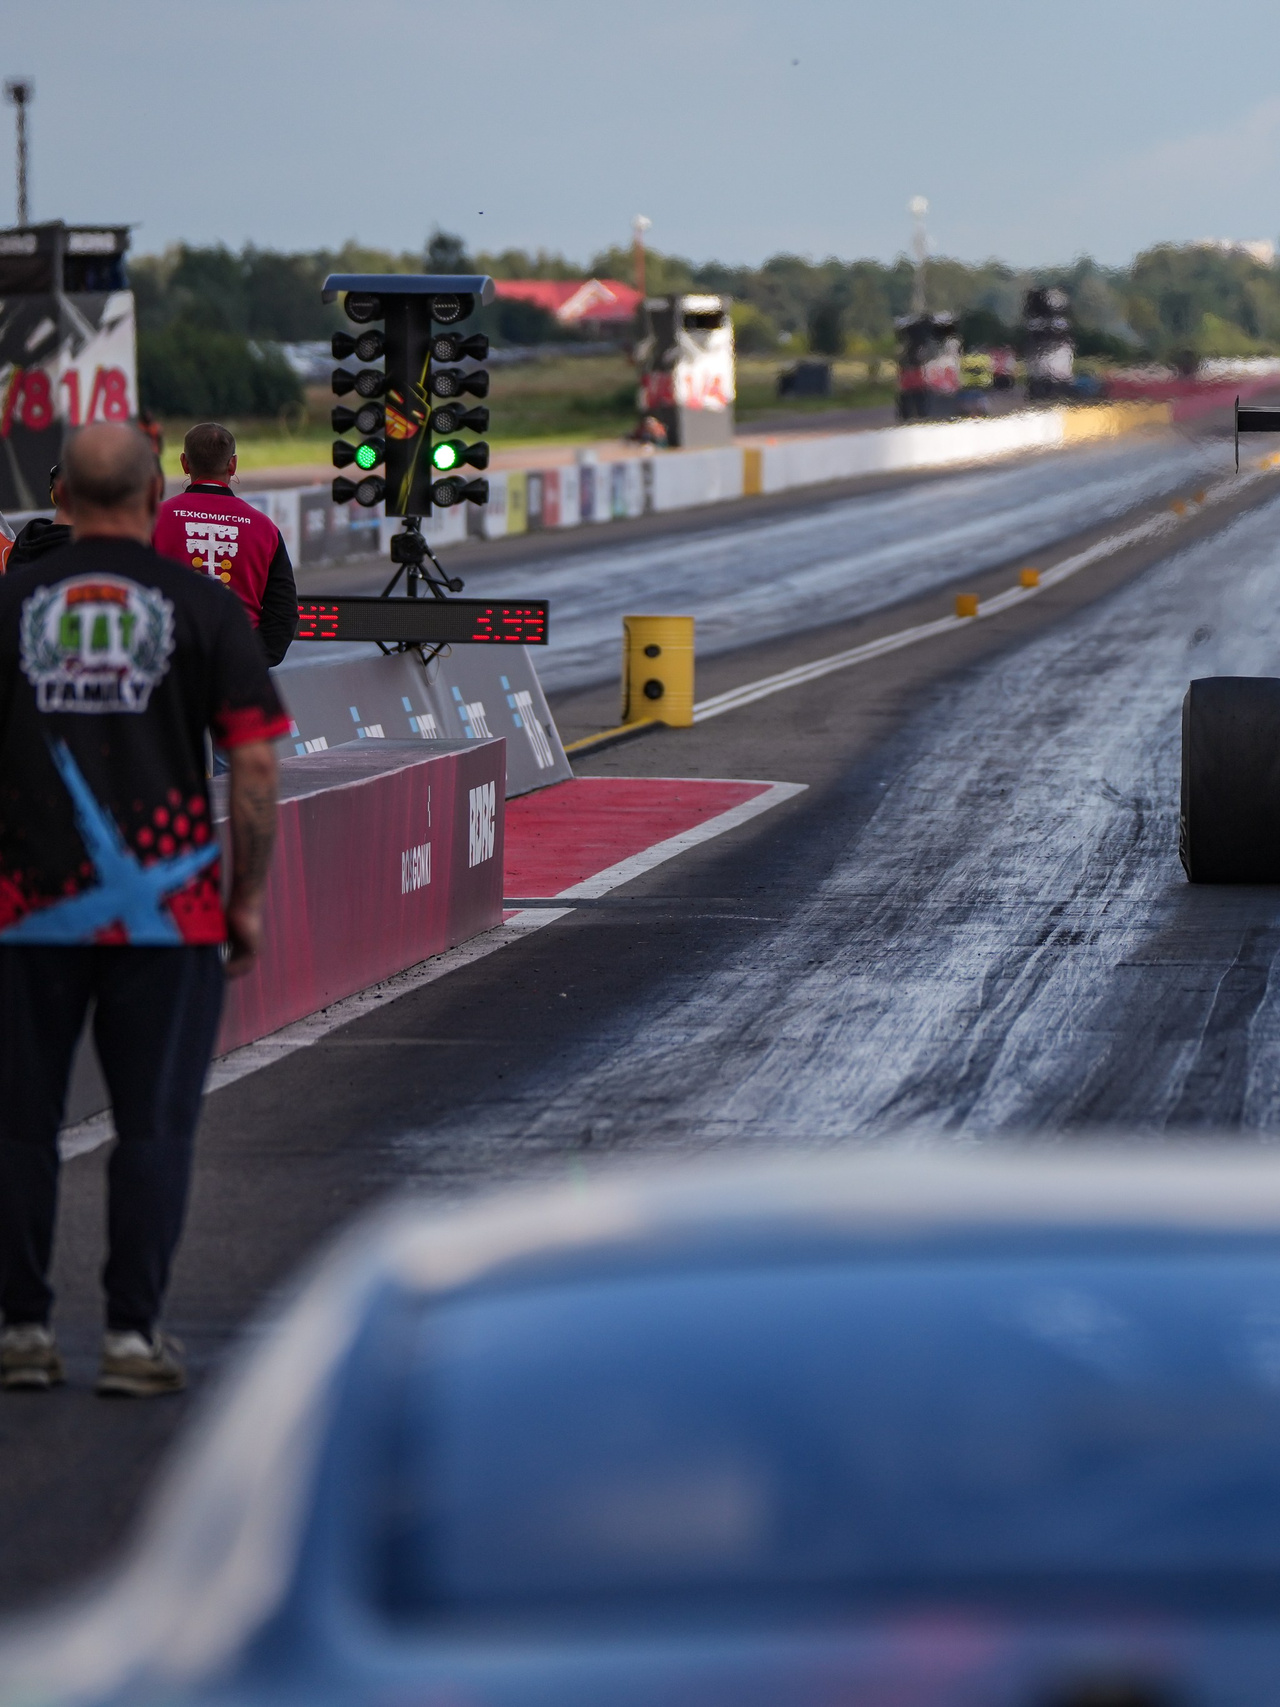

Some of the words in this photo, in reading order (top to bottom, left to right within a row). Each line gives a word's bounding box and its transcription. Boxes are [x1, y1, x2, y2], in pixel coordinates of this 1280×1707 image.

[61, 364, 130, 428] 1/8
[173, 509, 251, 525] ТЕХКОМИССИЯ
[469, 780, 496, 868] RDRC
[402, 841, 431, 895] ROSGONKI
